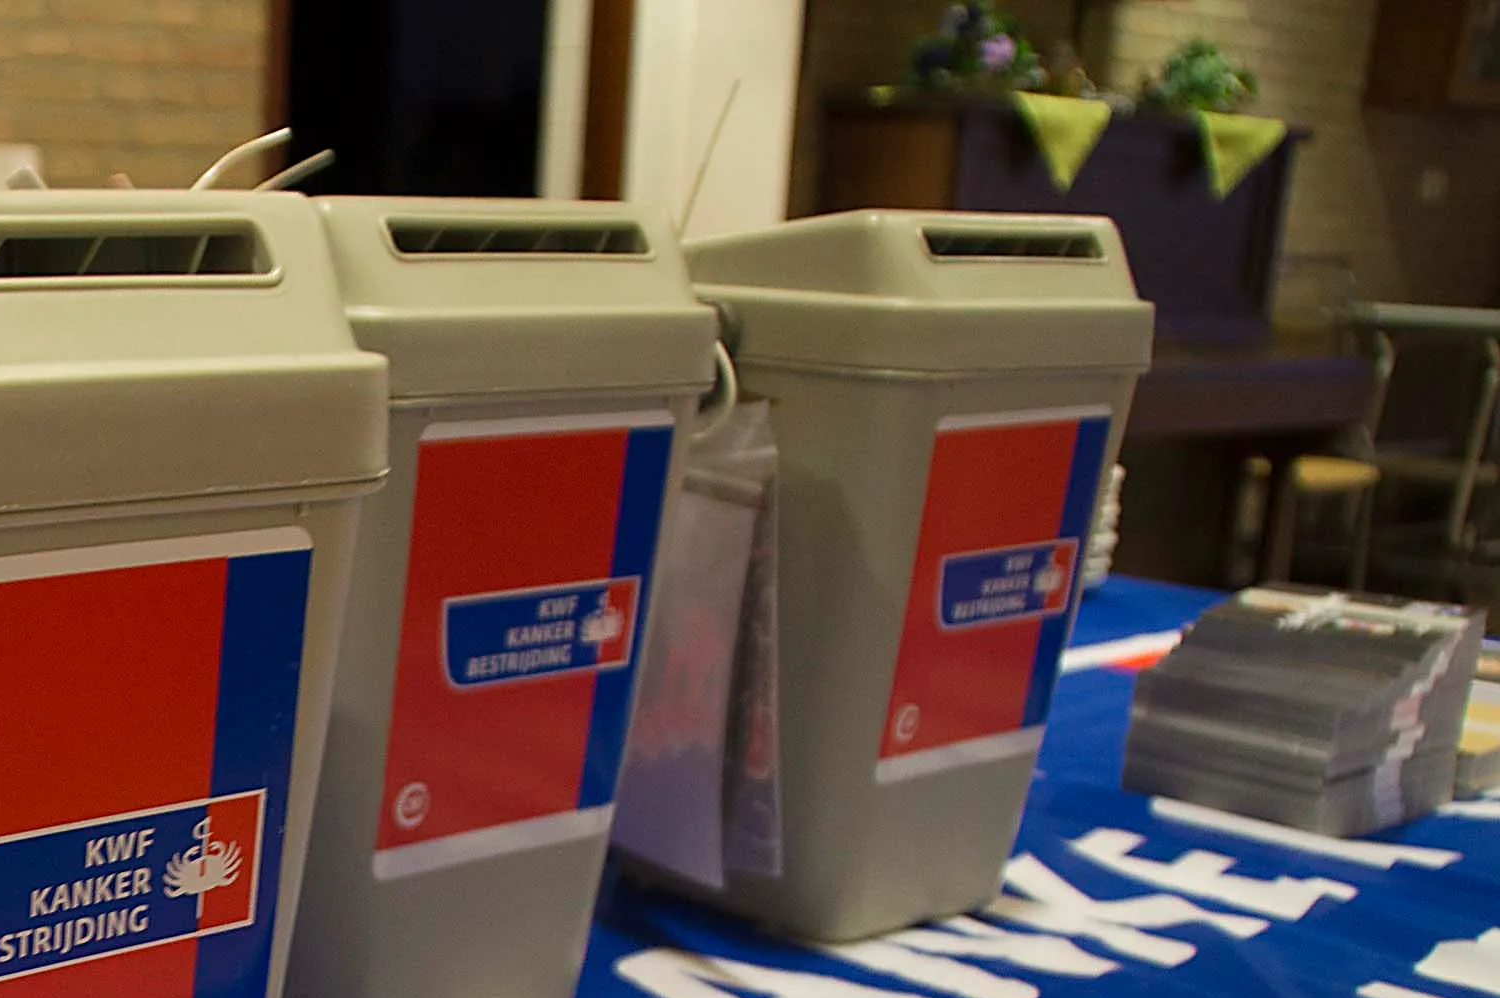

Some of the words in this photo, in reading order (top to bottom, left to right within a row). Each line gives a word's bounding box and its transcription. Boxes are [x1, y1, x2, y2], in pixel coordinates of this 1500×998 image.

[539, 595, 580, 619] KWF
[508, 619, 576, 648] KANKER
[466, 644, 572, 677] BESTRIJDING
[85, 828, 155, 869] KWF
[29, 868, 153, 917] KANKER
